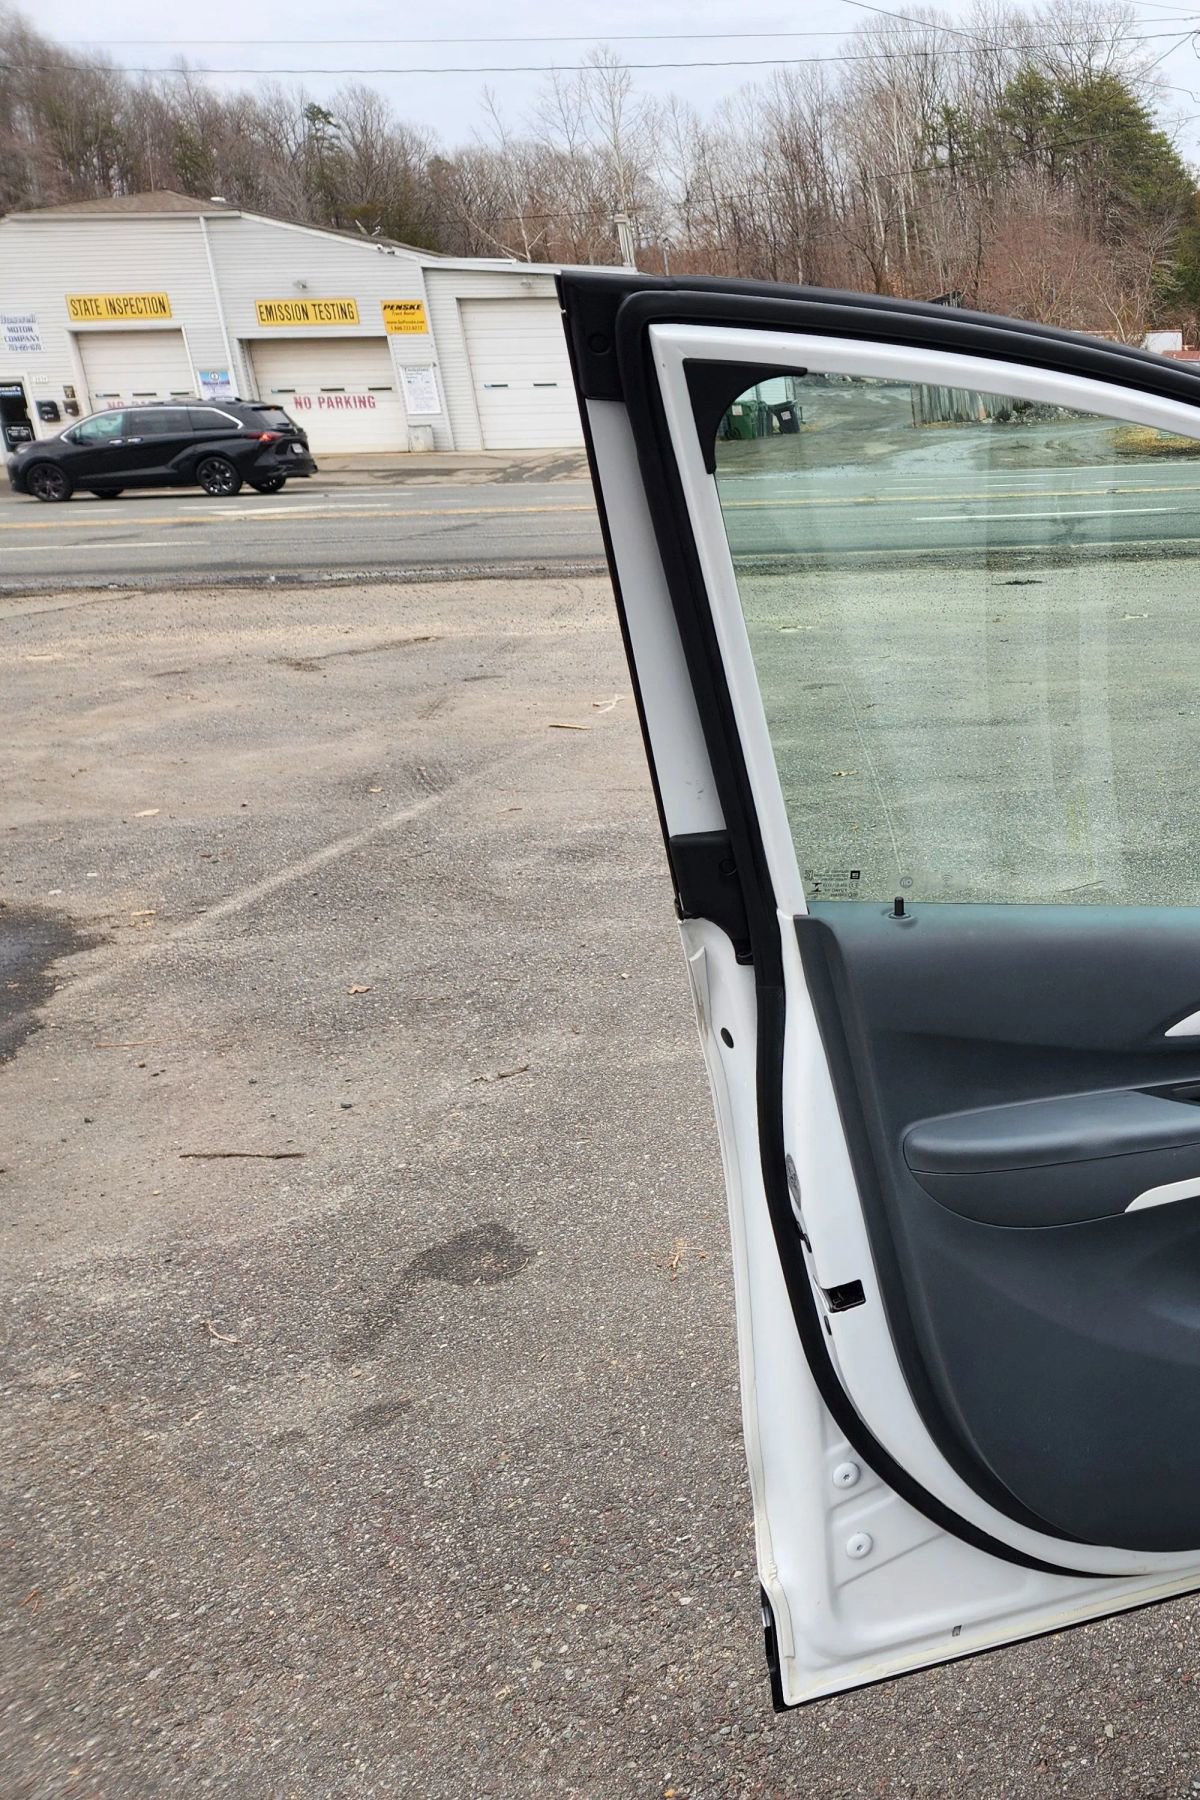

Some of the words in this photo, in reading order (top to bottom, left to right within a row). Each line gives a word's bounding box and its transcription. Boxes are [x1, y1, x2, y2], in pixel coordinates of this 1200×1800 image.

[70, 298, 102, 317] STATE
[105, 296, 167, 315] INSPECTION
[260, 303, 309, 322] EMISSION
[311, 302, 355, 321] TESTING
[383, 303, 422, 311] PENSKE
[4, 334, 39, 343] COMPANY
[294, 397, 312, 410] NO
[318, 395, 376, 409] PARKING
